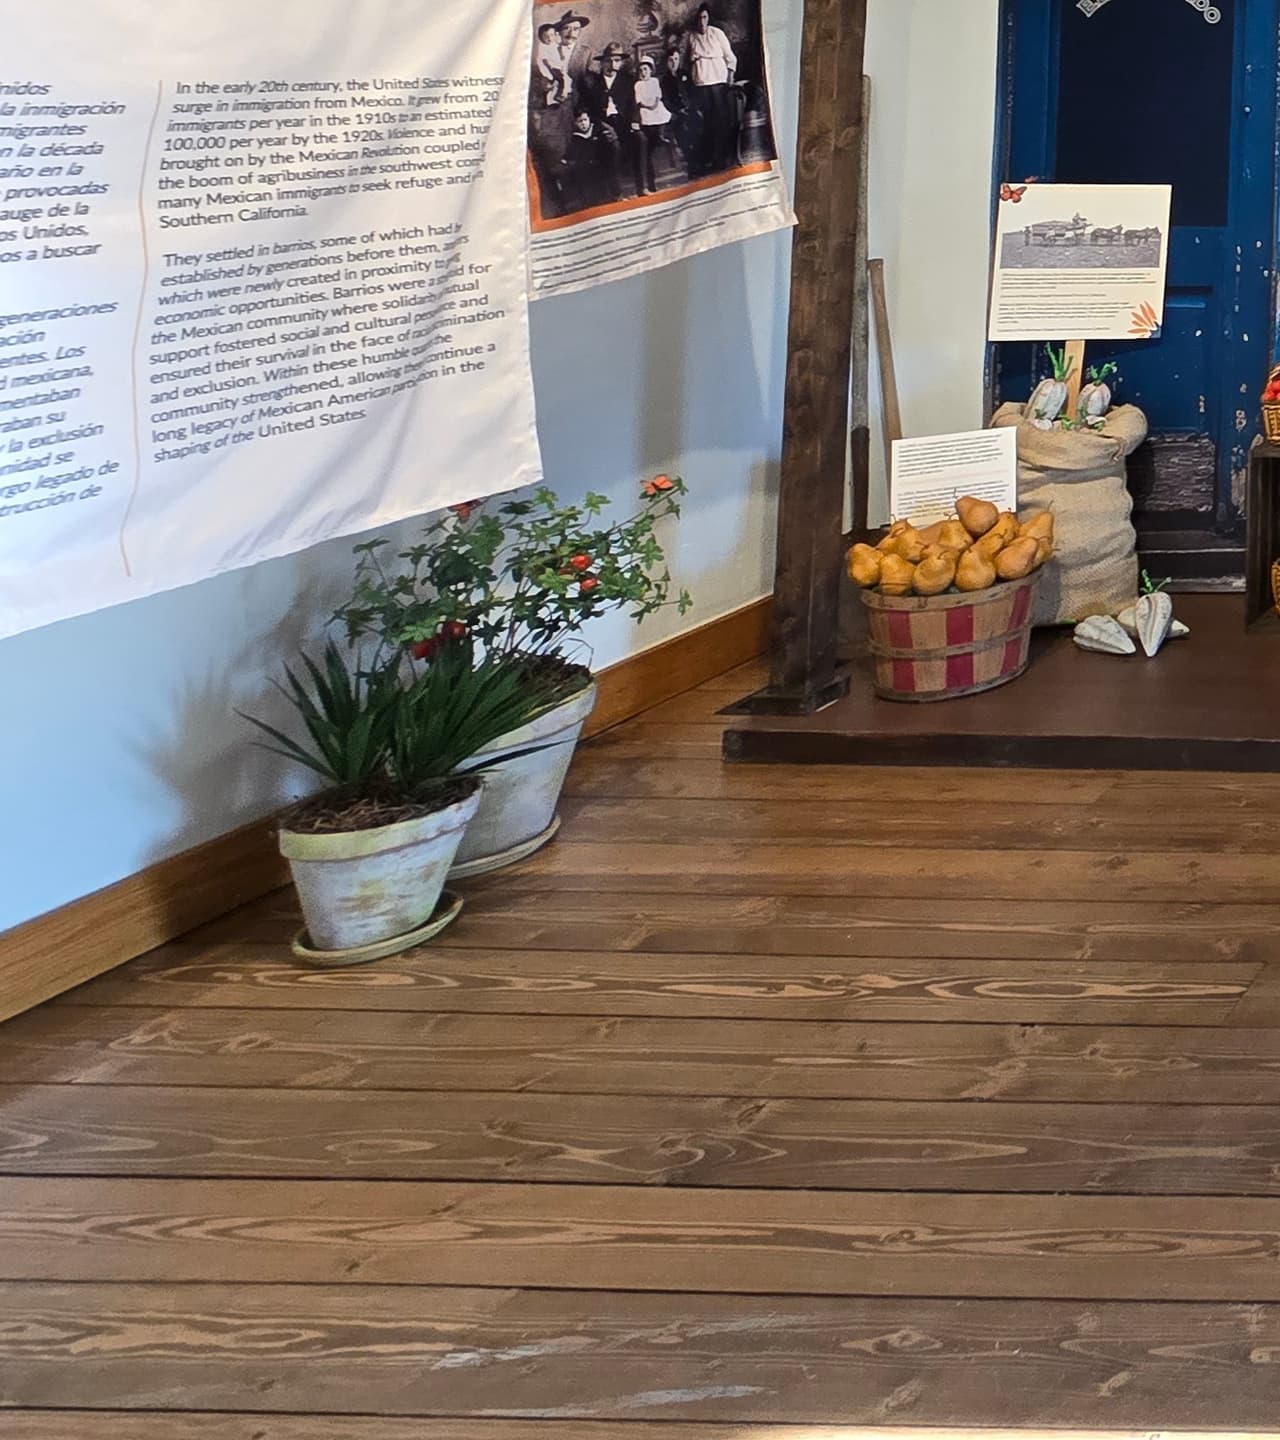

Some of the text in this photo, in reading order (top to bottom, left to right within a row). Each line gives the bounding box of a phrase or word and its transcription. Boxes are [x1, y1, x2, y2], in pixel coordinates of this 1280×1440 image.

[177, 78, 419, 96] In the early 20th century, the United
[19, 102, 126, 118] inmigración
[173, 101, 212, 115] surge
[217, 100, 229, 111] in
[232, 98, 310, 112] immigration
[315, 98, 347, 109] from
[167, 107, 492, 133] immigrants per year in the 1910s estimated
[164, 137, 225, 151] 100,000
[230, 137, 252, 150] per
[256, 135, 287, 148] year
[292, 133, 309, 147] by
[314, 132, 338, 144] the
[160, 213, 234, 228] Southern
[154, 442, 210, 463] shaping
[214, 434, 229, 448] of
[232, 430, 254, 444] the
[259, 419, 315, 438] United
